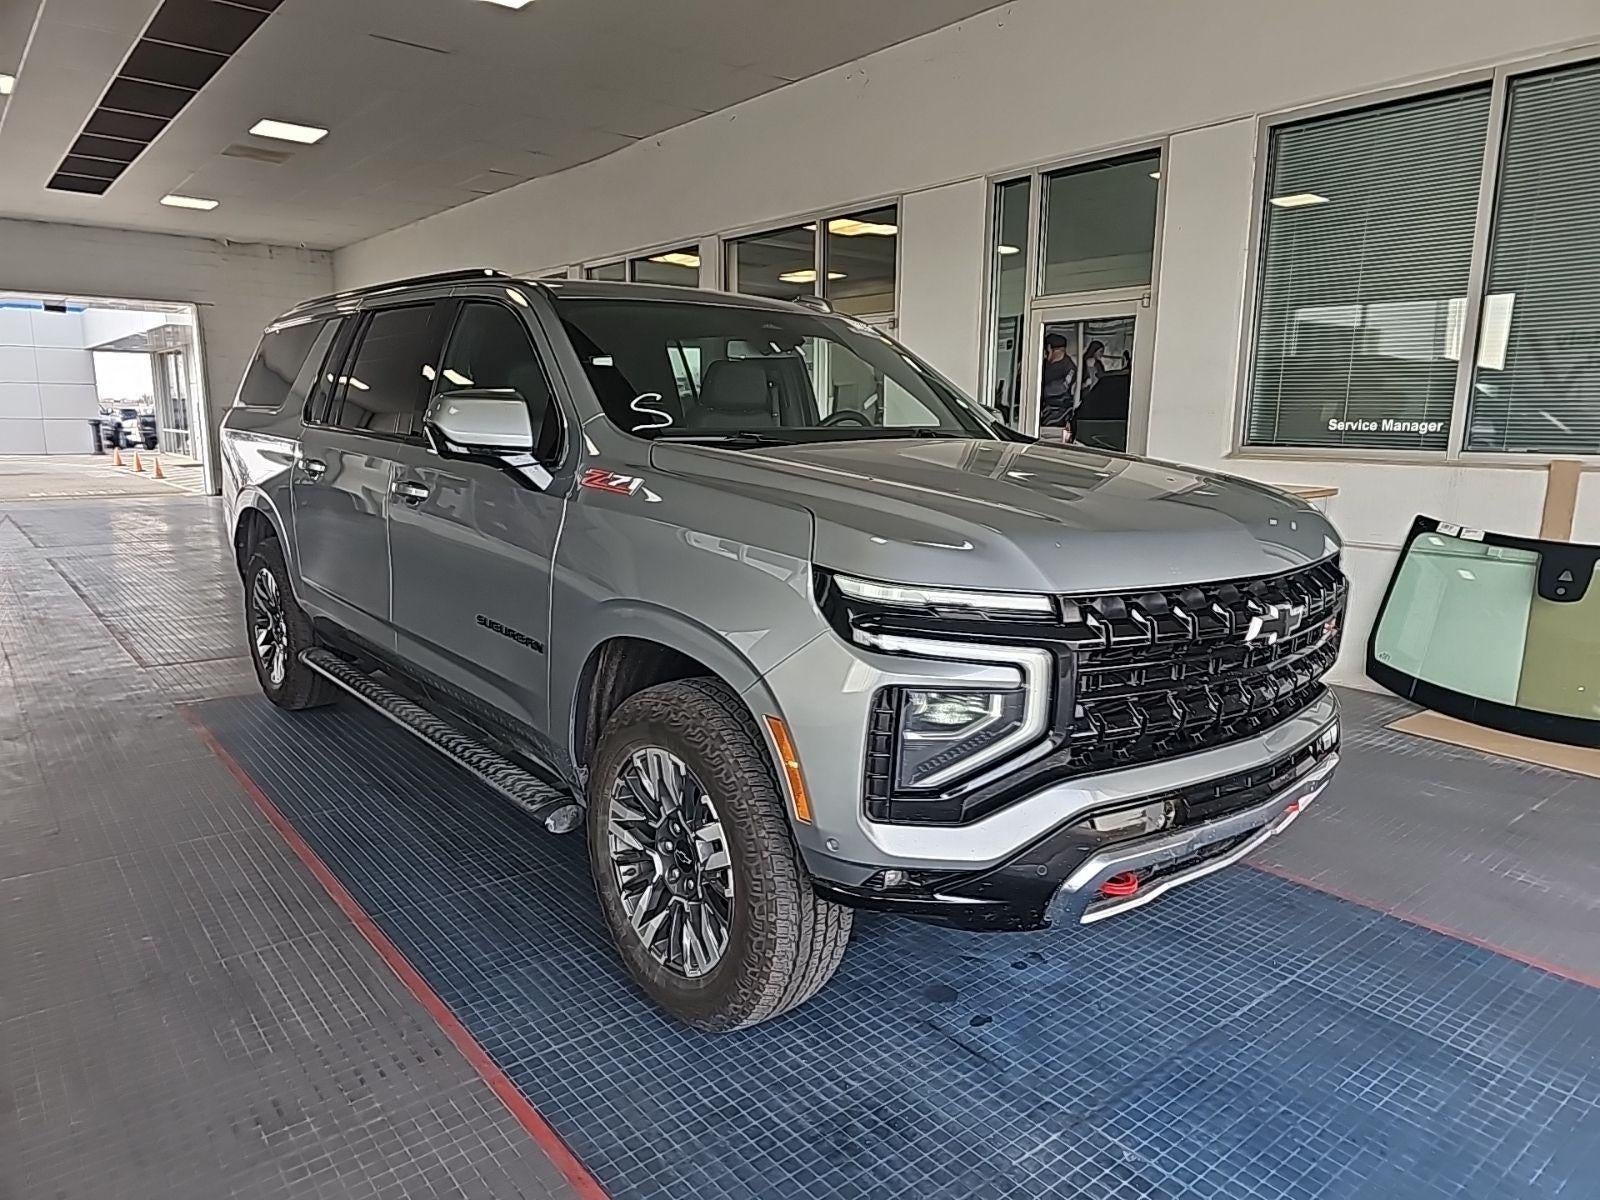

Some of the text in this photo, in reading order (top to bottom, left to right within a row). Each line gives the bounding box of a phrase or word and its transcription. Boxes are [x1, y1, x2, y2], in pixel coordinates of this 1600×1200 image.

[630, 393, 673, 431] S
[1328, 418, 1443, 434] Service Manager
[581, 468, 645, 496] Z71
[476, 614, 544, 654] SUBURBAN
